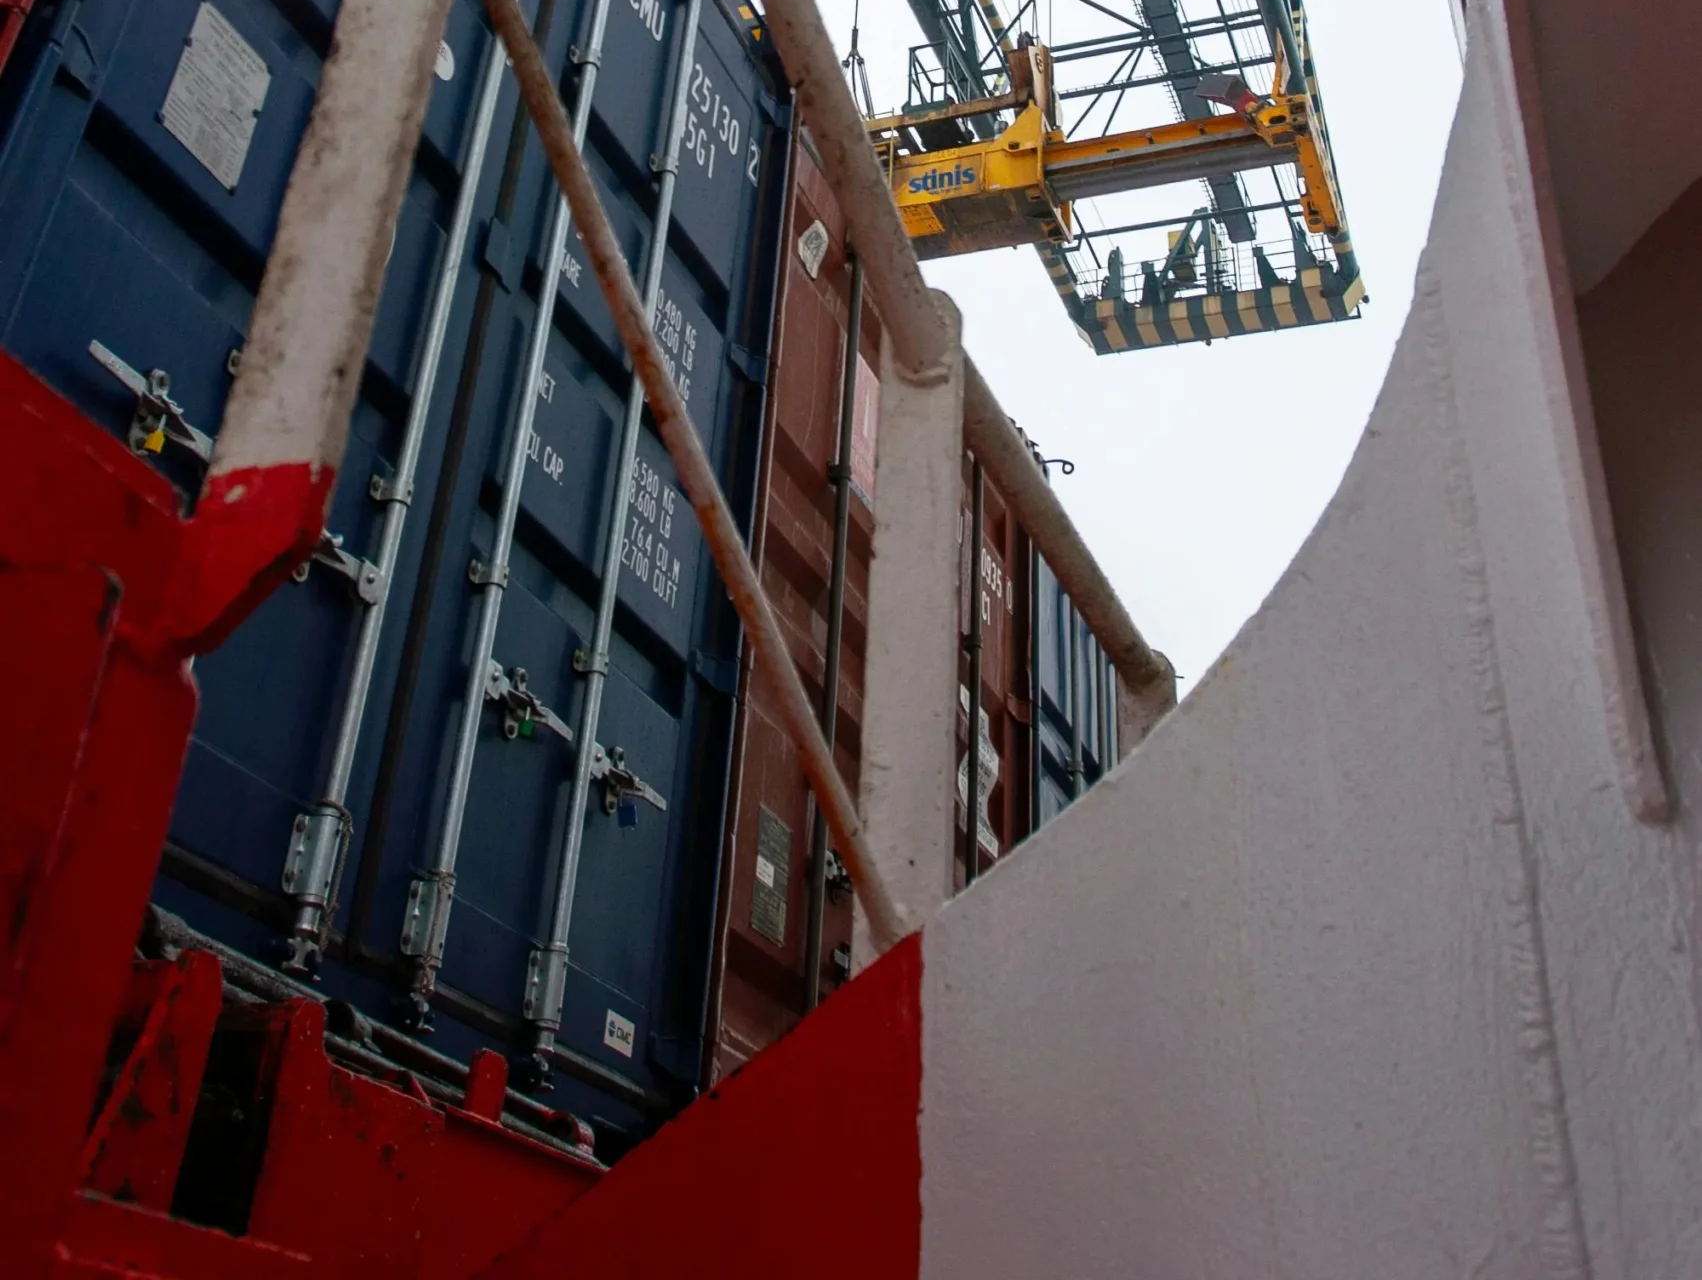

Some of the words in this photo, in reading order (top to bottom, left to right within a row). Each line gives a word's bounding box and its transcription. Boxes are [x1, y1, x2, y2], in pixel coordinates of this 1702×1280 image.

[690, 63, 740, 156] 25130
[682, 111, 716, 180] 5G1
[908, 163, 977, 194] stinis
[560, 248, 583, 289] ARE
[685, 322, 697, 351] KG
[682, 343, 694, 372] LB
[678, 371, 691, 401] KG
[662, 485, 676, 516] KG
[659, 509, 672, 539] LB
[981, 547, 1003, 598] 0935
